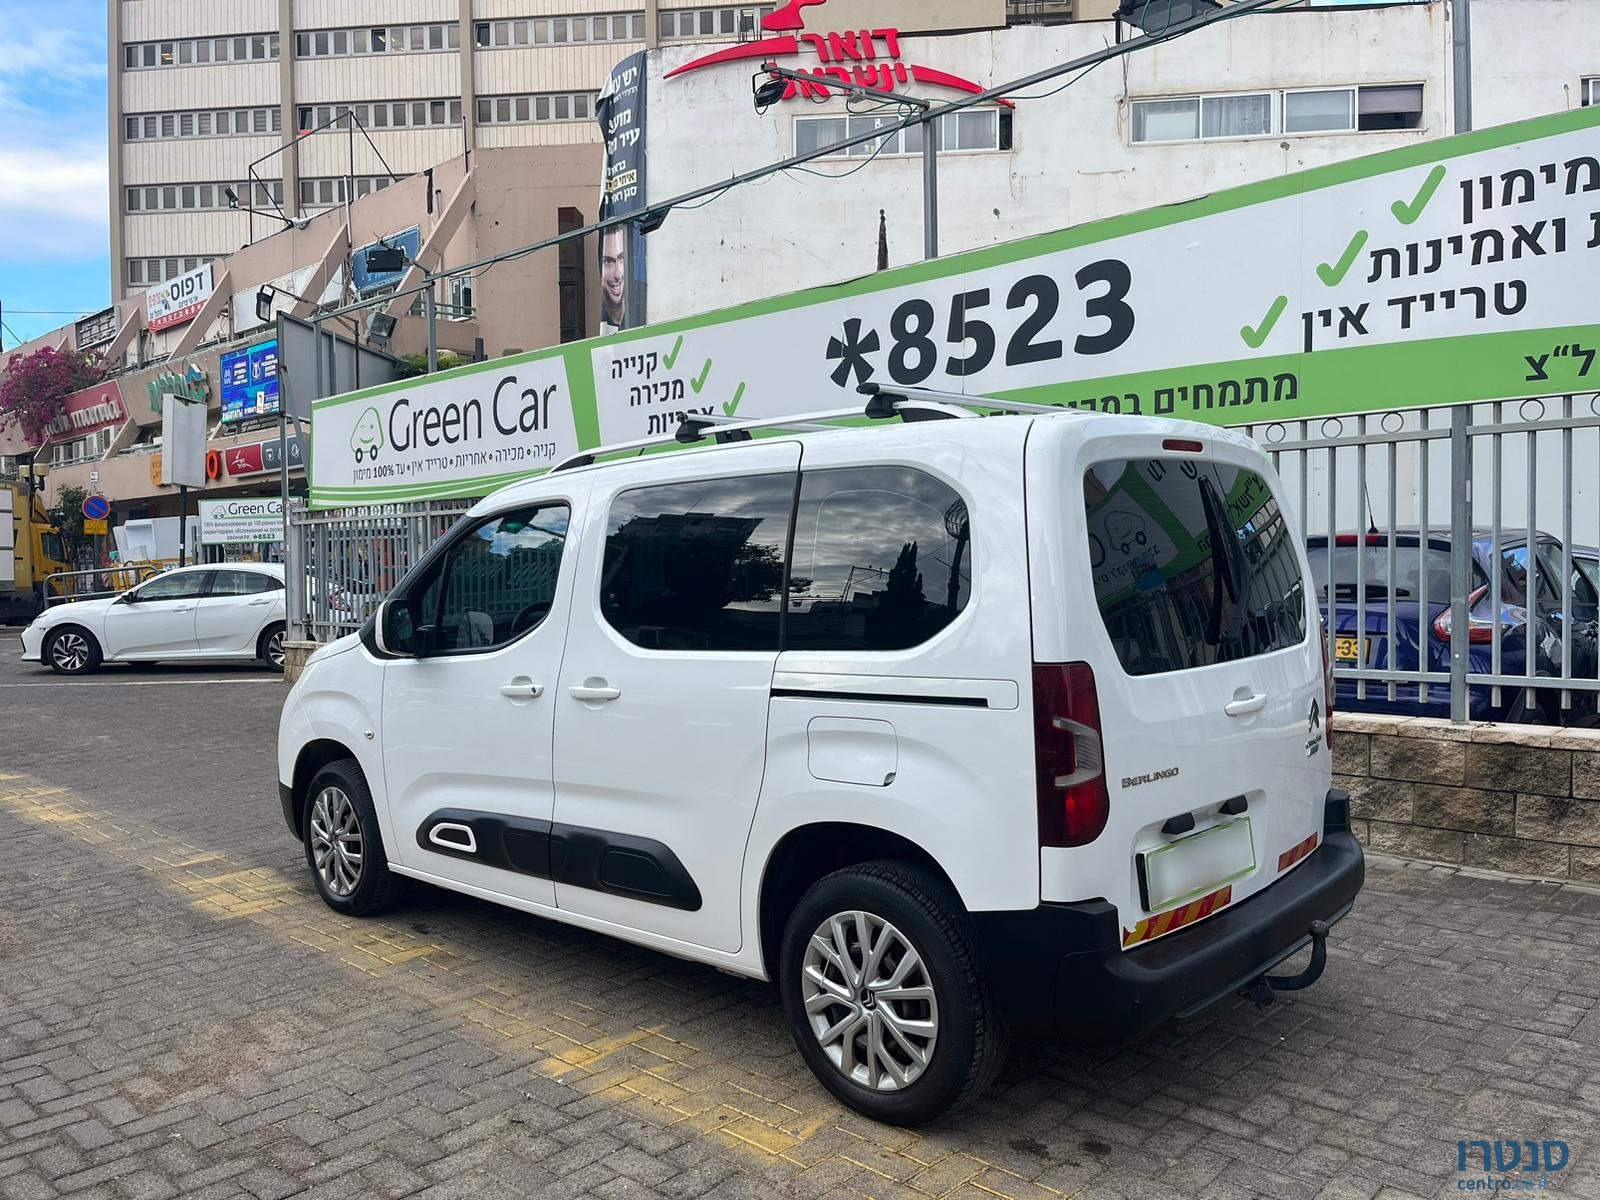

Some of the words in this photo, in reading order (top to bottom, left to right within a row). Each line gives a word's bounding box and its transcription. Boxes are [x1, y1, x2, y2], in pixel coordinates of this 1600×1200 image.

[800, 28, 901, 63] דואר
[1460, 156, 1600, 225] מימון
[1367, 217, 1566, 283] ואמינות
[170, 271, 203, 301] דפוס
[1387, 279, 1527, 330] טרייד
[1302, 302, 1371, 353] אין
[611, 352, 658, 379] קנייה
[630, 378, 684, 406] מכירה
[1154, 373, 1298, 415] מתמחים
[388, 398, 482, 452] Green
[492, 375, 557, 436] Car
[455, 452, 487, 467] אחריות
[495, 446, 524, 463] מכירה
[533, 442, 556, 460] קניה
[353, 468, 371, 485] מימון
[373, 465, 395, 478] 100%
[228, 502, 265, 515] Green
[267, 501, 283, 514] Ca
